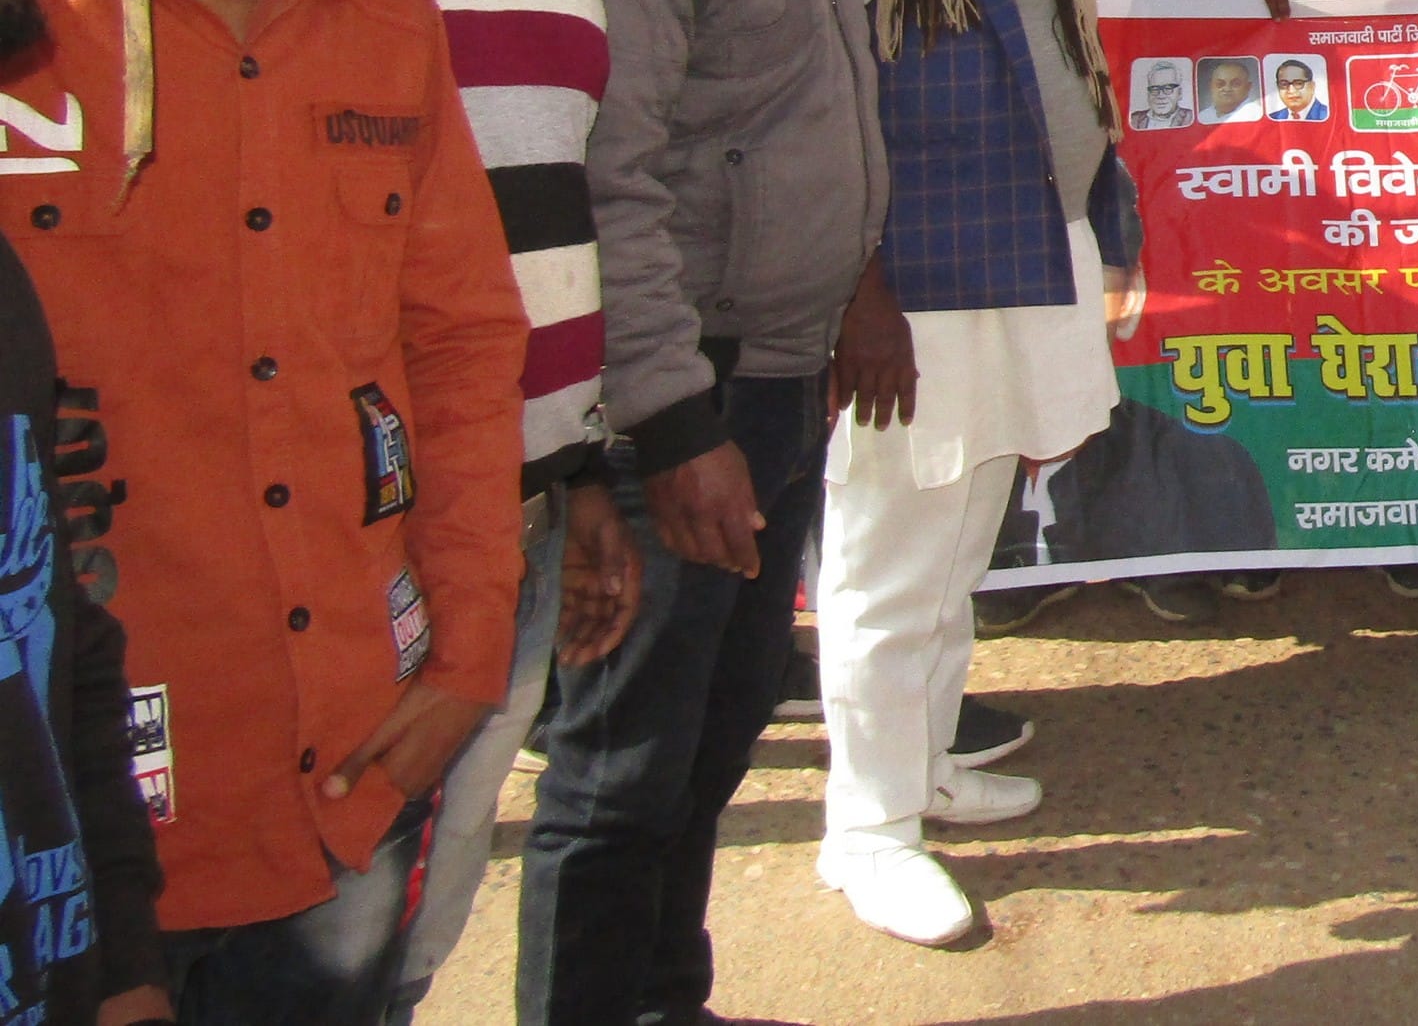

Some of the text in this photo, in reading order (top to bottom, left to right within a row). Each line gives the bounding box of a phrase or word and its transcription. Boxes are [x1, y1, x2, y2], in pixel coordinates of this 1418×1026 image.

[1309, 25, 1374, 45] समाजवादी
[1378, 25, 1402, 44] पार्टी
[1176, 149, 1318, 200] स्वामी
[1322, 209, 1381, 247] की
[1192, 260, 1241, 294] के
[1258, 269, 1387, 295] अवसर
[1162, 333, 1295, 426] युवा
[1287, 447, 1359, 474] नगर
